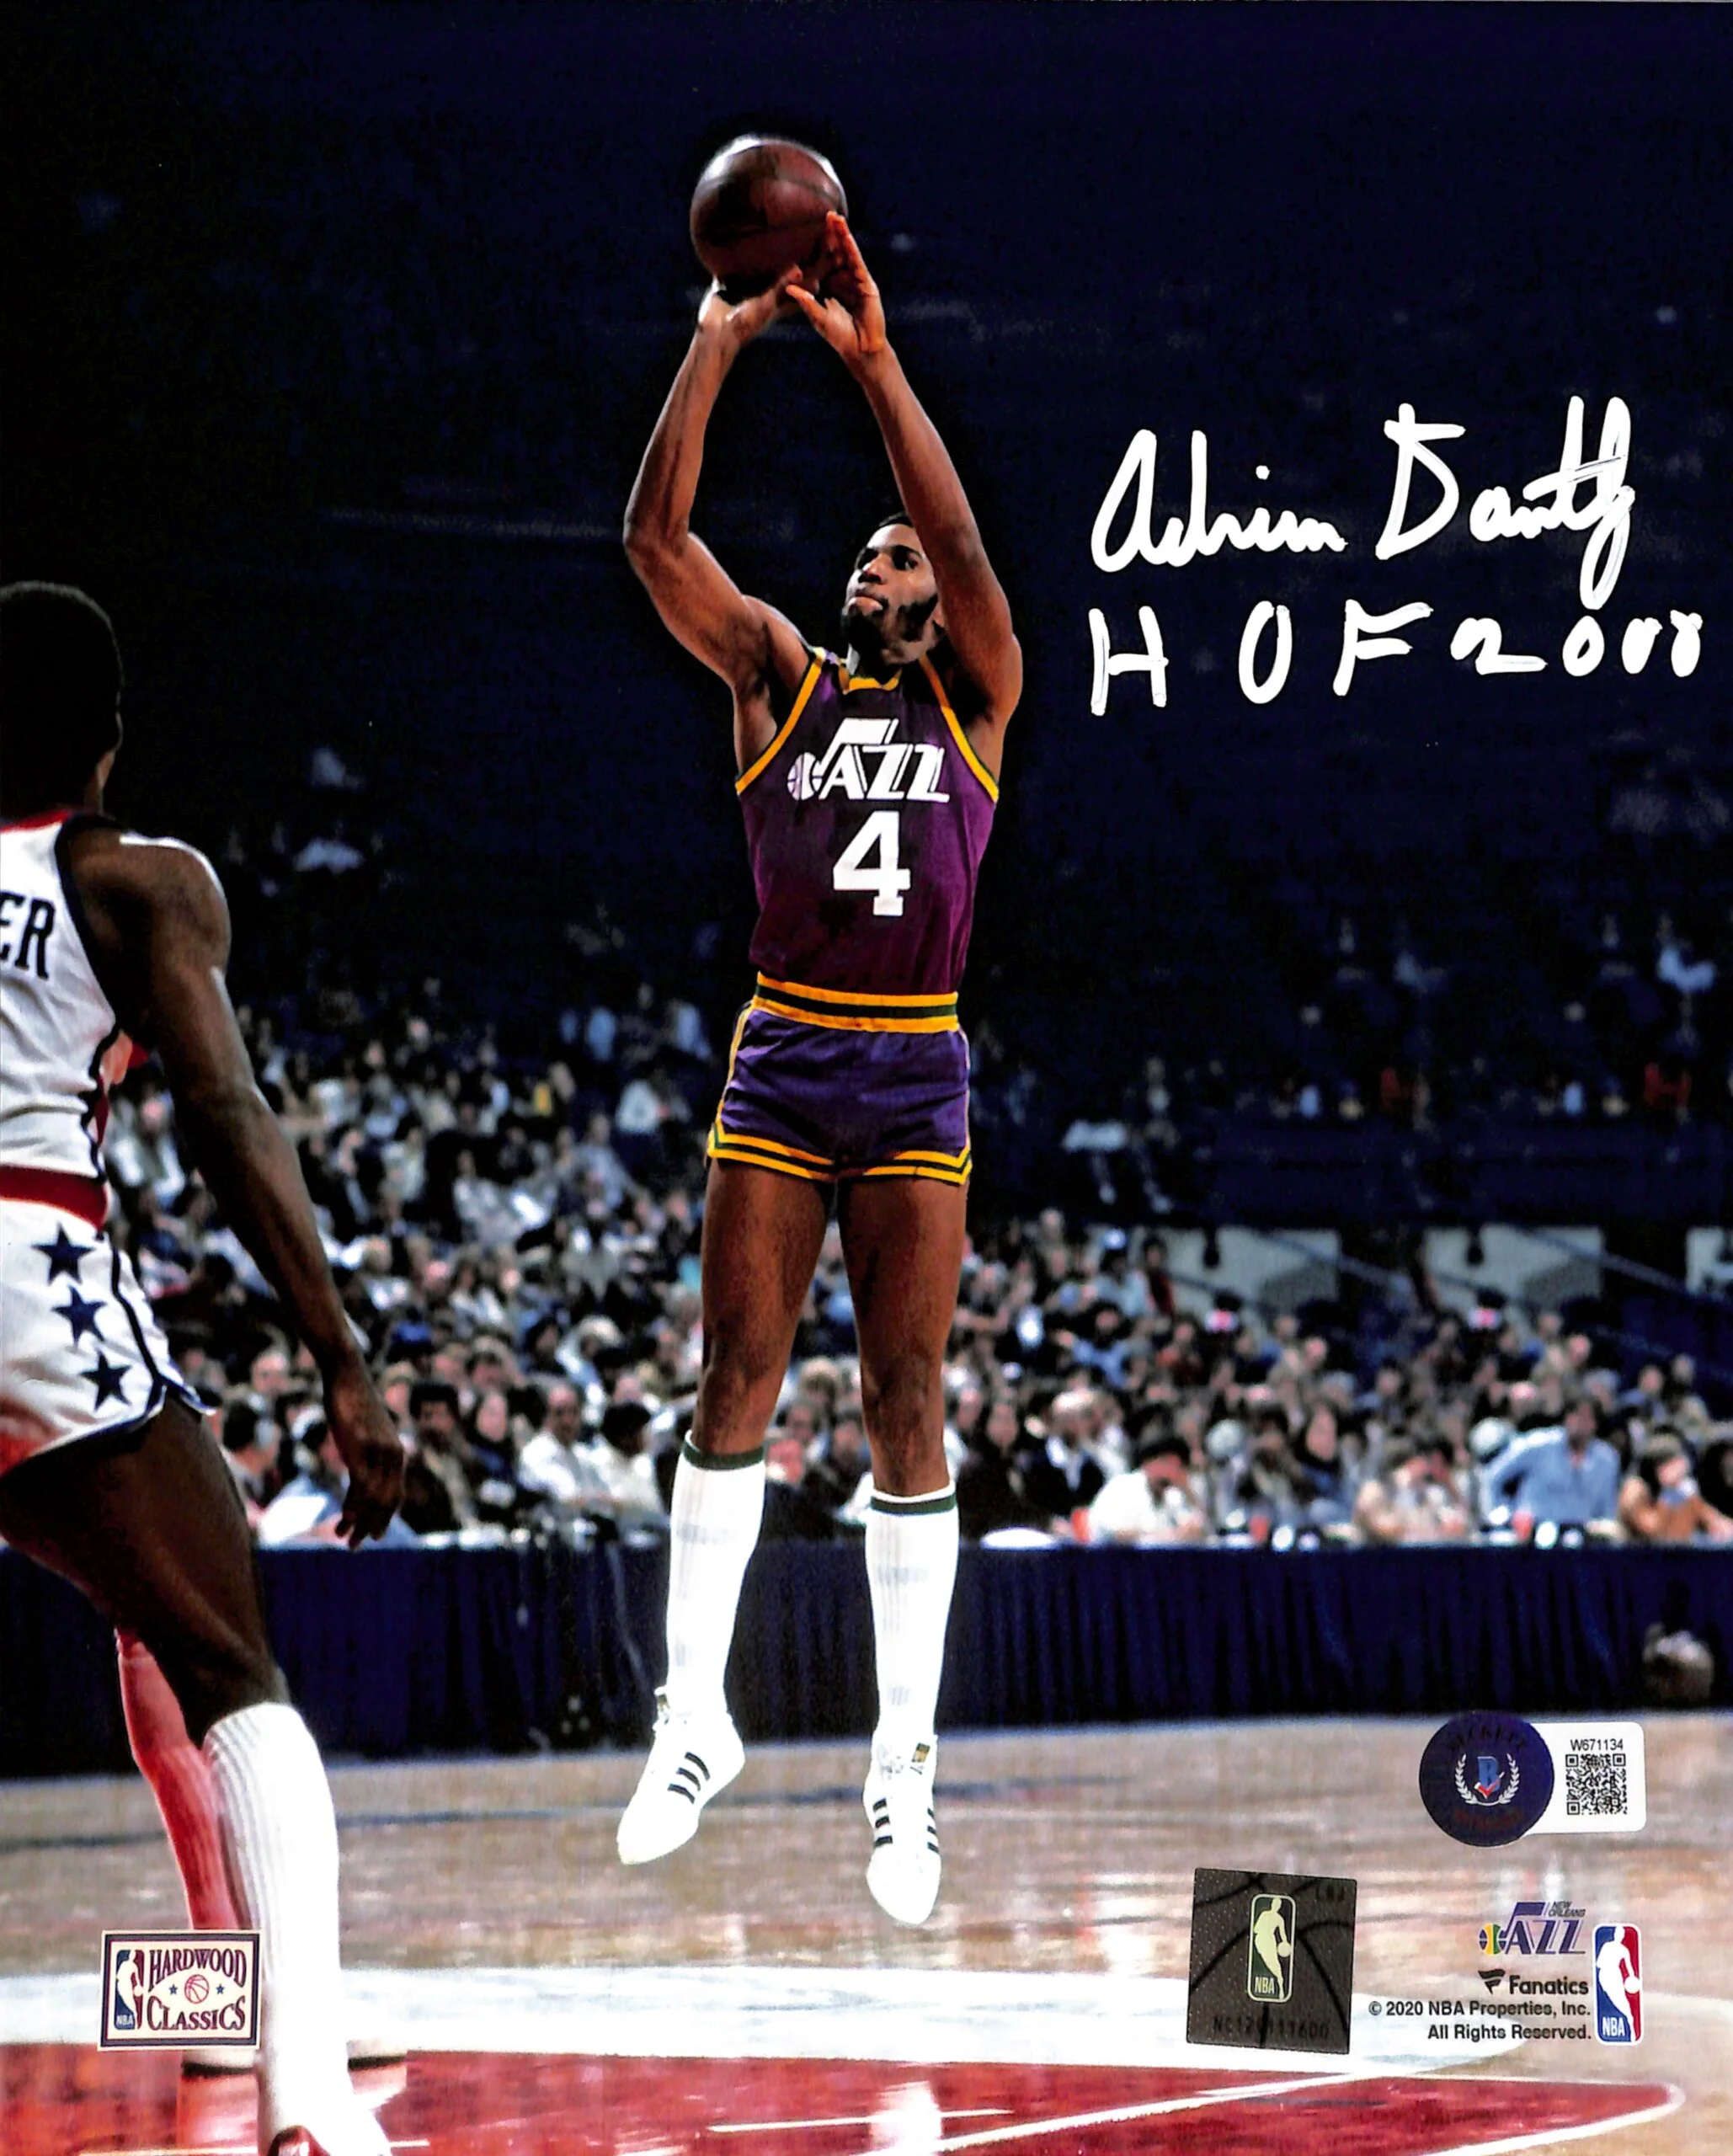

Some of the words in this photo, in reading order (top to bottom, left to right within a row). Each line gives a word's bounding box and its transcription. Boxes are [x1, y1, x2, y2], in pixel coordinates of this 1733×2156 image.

[833, 810, 910, 916] 4
[1570, 1738, 1624, 1751] W671134
[1255, 1977, 1275, 1994] NBA
